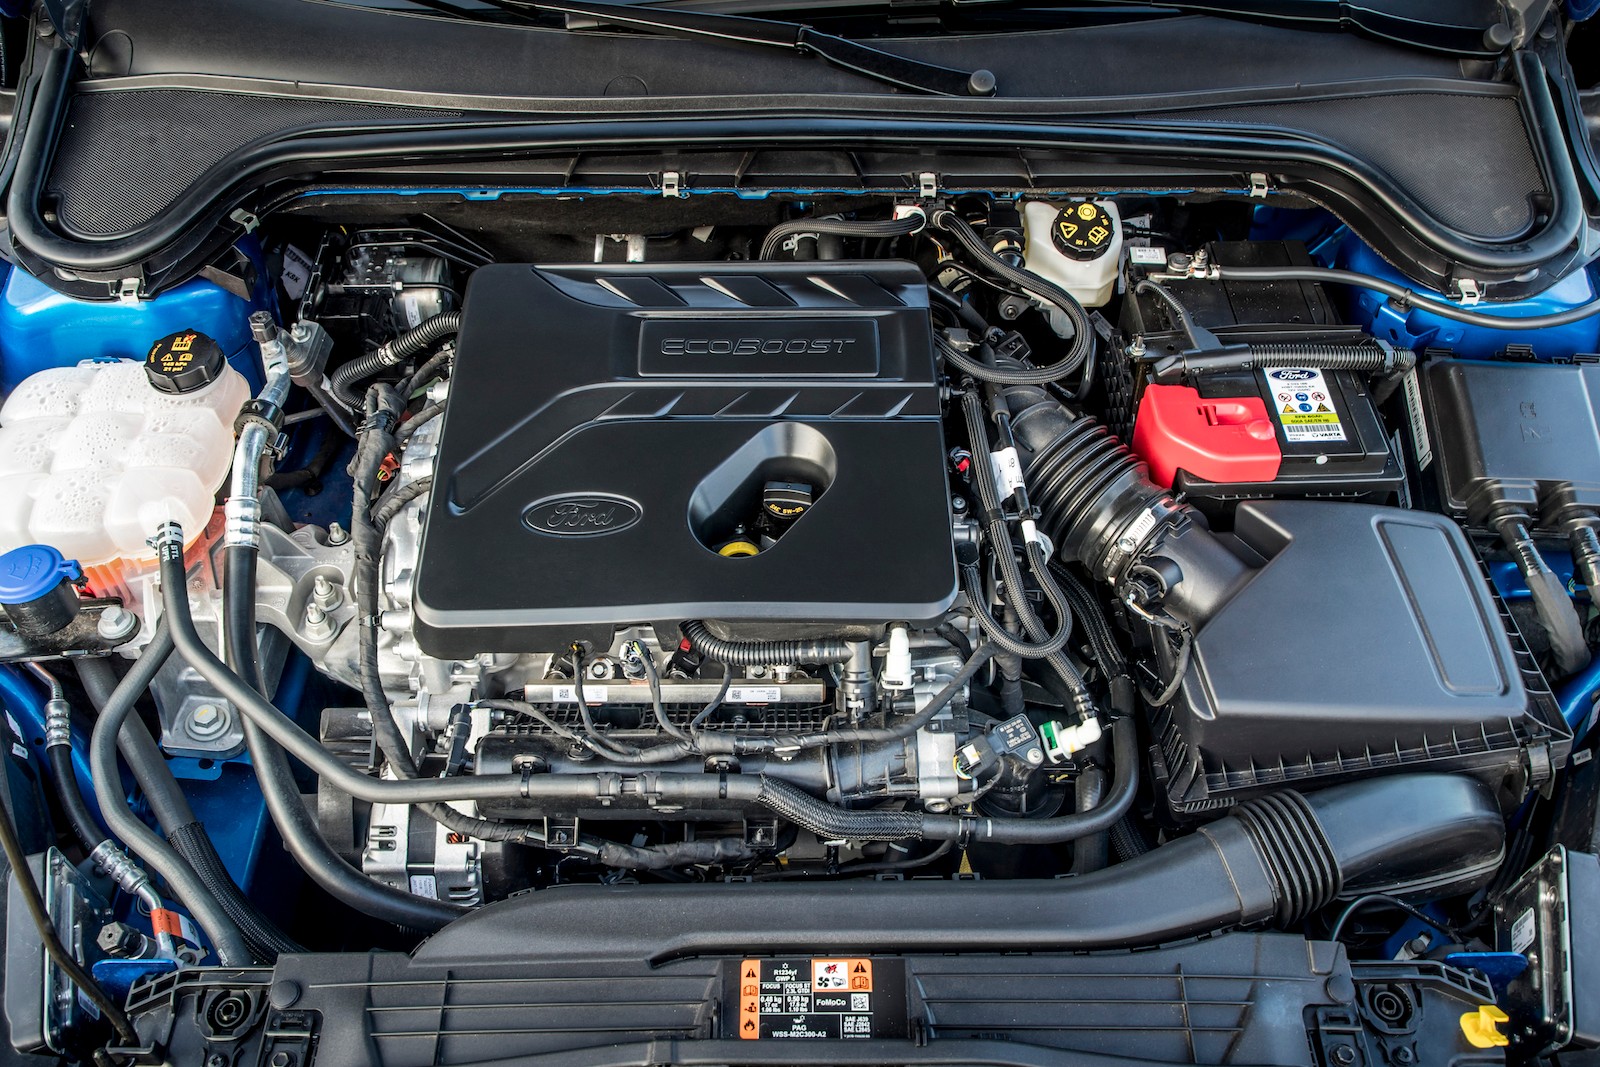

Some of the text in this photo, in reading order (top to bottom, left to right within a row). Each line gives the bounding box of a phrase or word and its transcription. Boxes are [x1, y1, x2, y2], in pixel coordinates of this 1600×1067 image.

[1278, 370, 1310, 380] Ford
[546, 502, 616, 528] Ford
[170, 544, 179, 560] BTL
[773, 996, 782, 1004] kg
[800, 996, 809, 1004] kg
